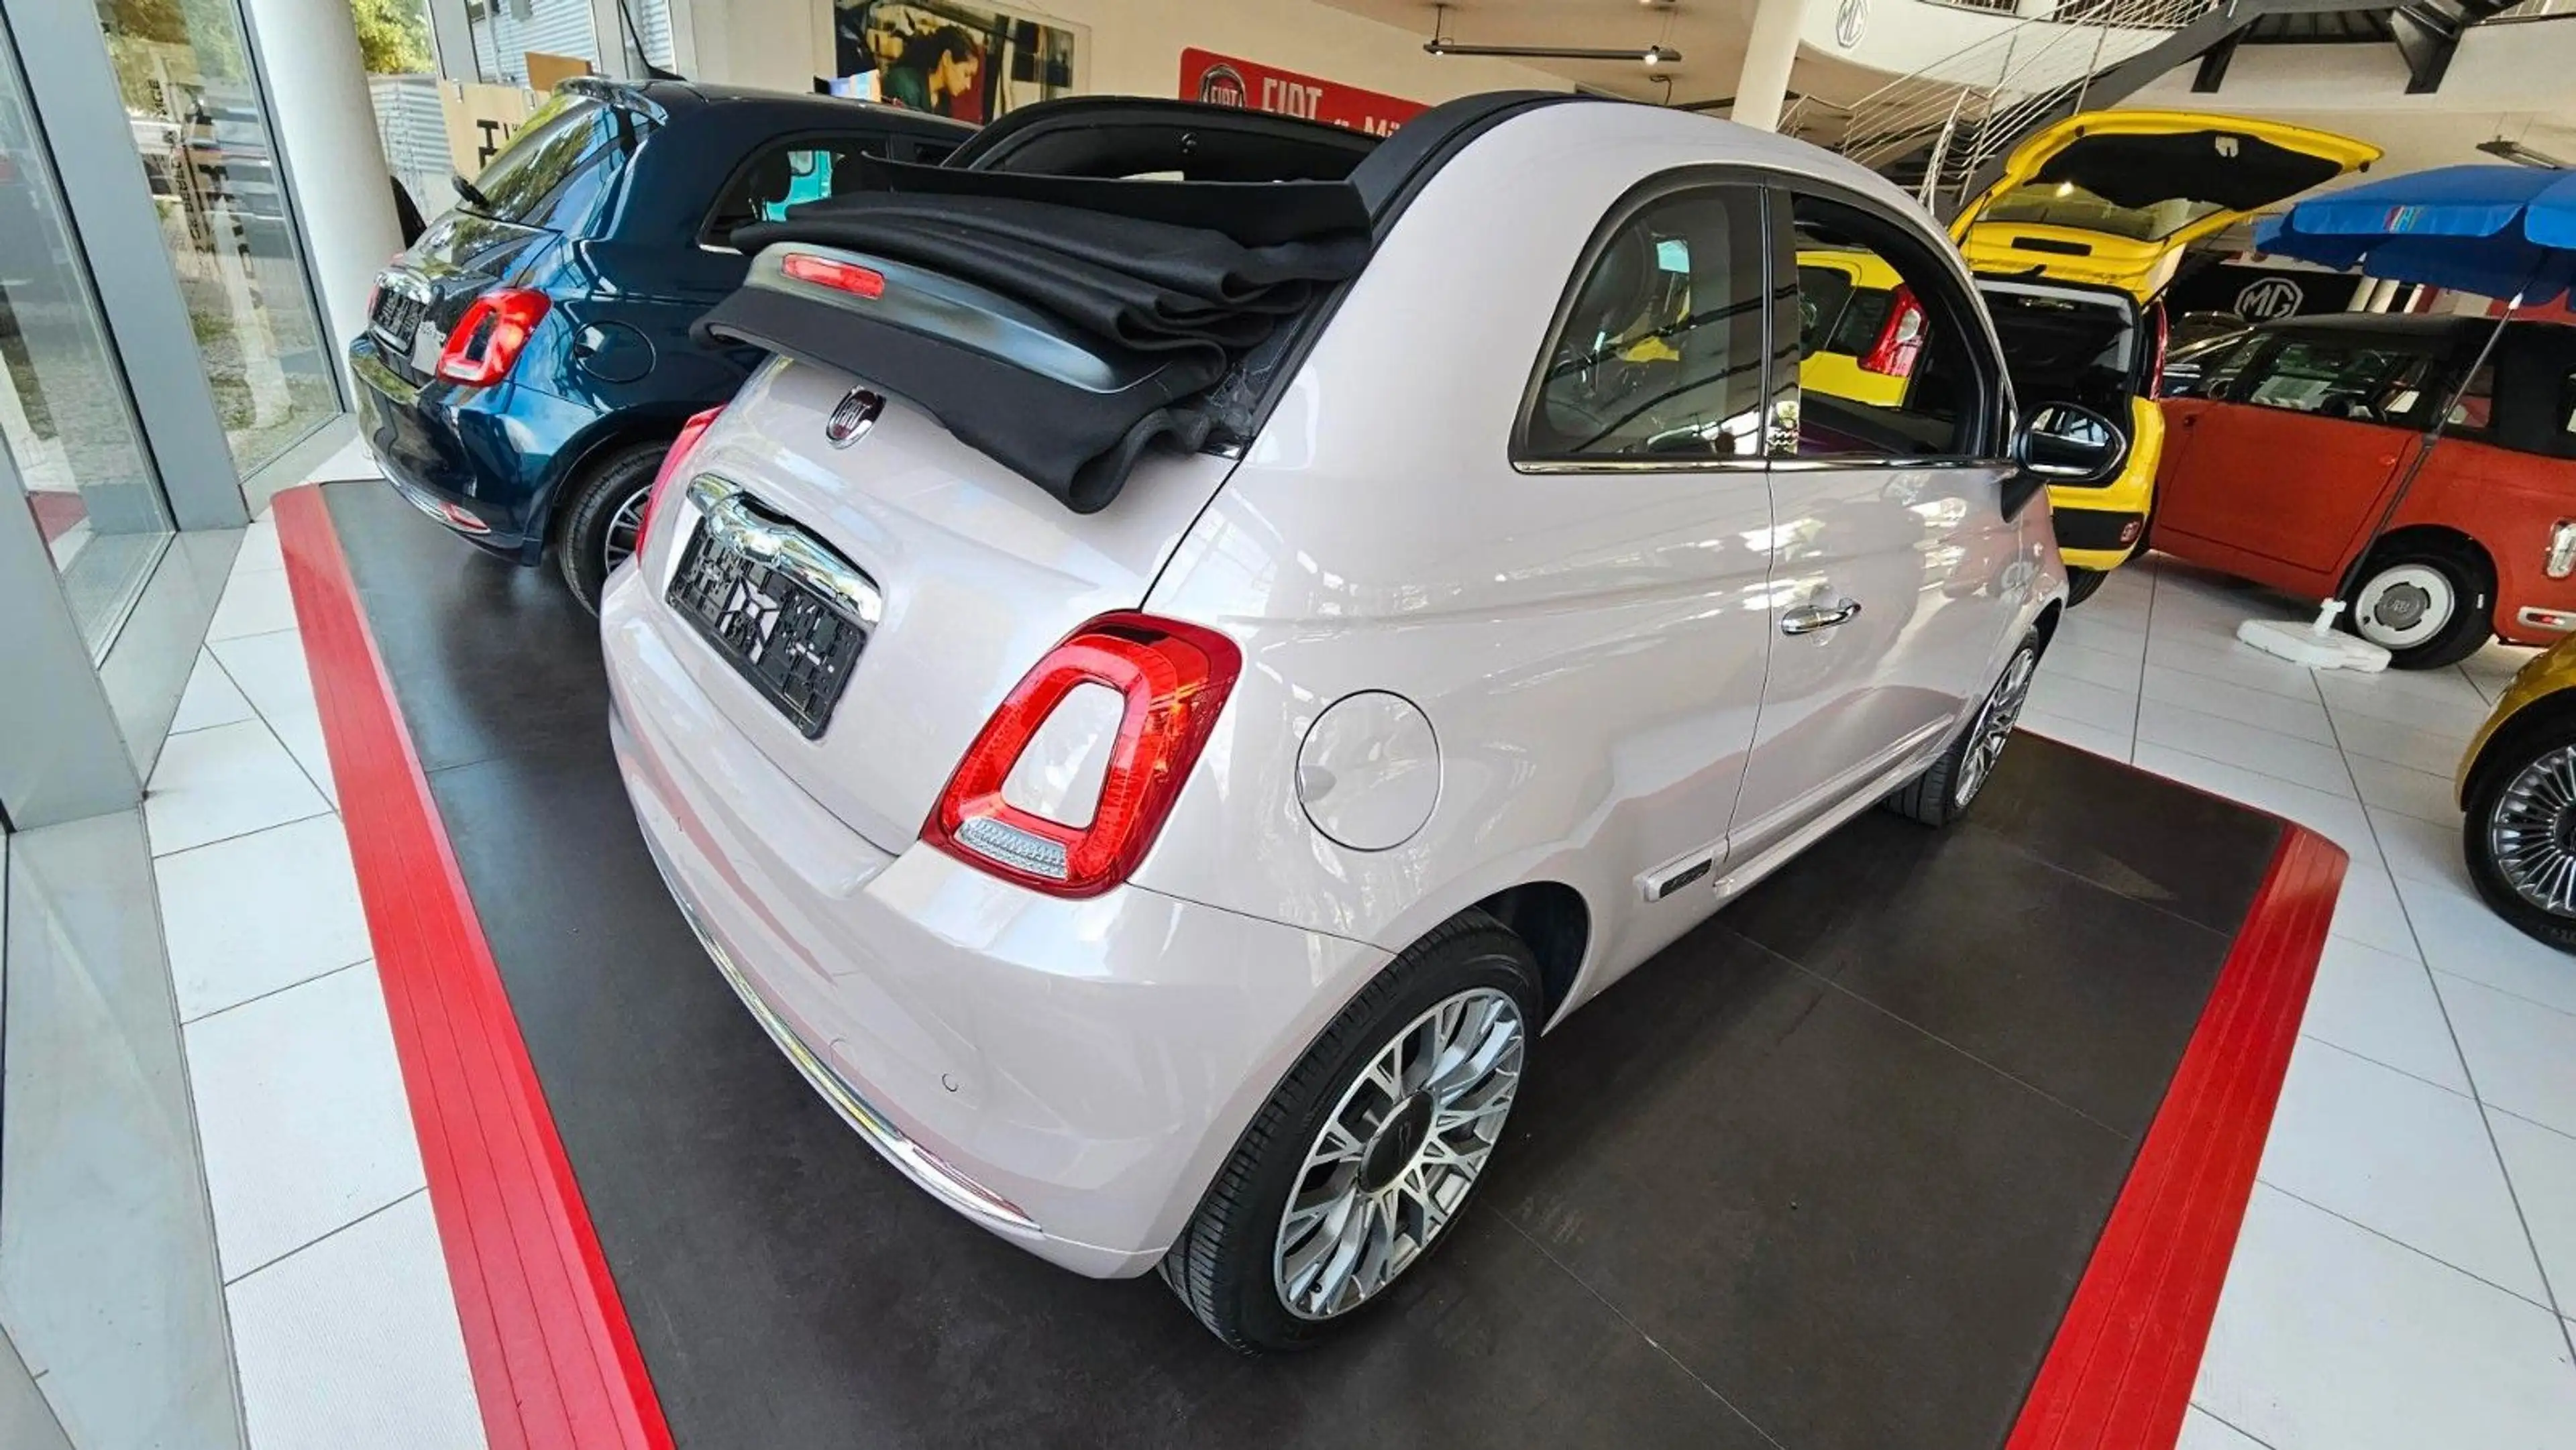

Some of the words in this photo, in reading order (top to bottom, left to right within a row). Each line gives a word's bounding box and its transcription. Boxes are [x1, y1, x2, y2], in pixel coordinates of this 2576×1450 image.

[1839, 0, 1864, 42] MG
[1210, 85, 1239, 107] FIAT
[1262, 78, 1322, 120] FIAT
[2242, 284, 2294, 318] MG
